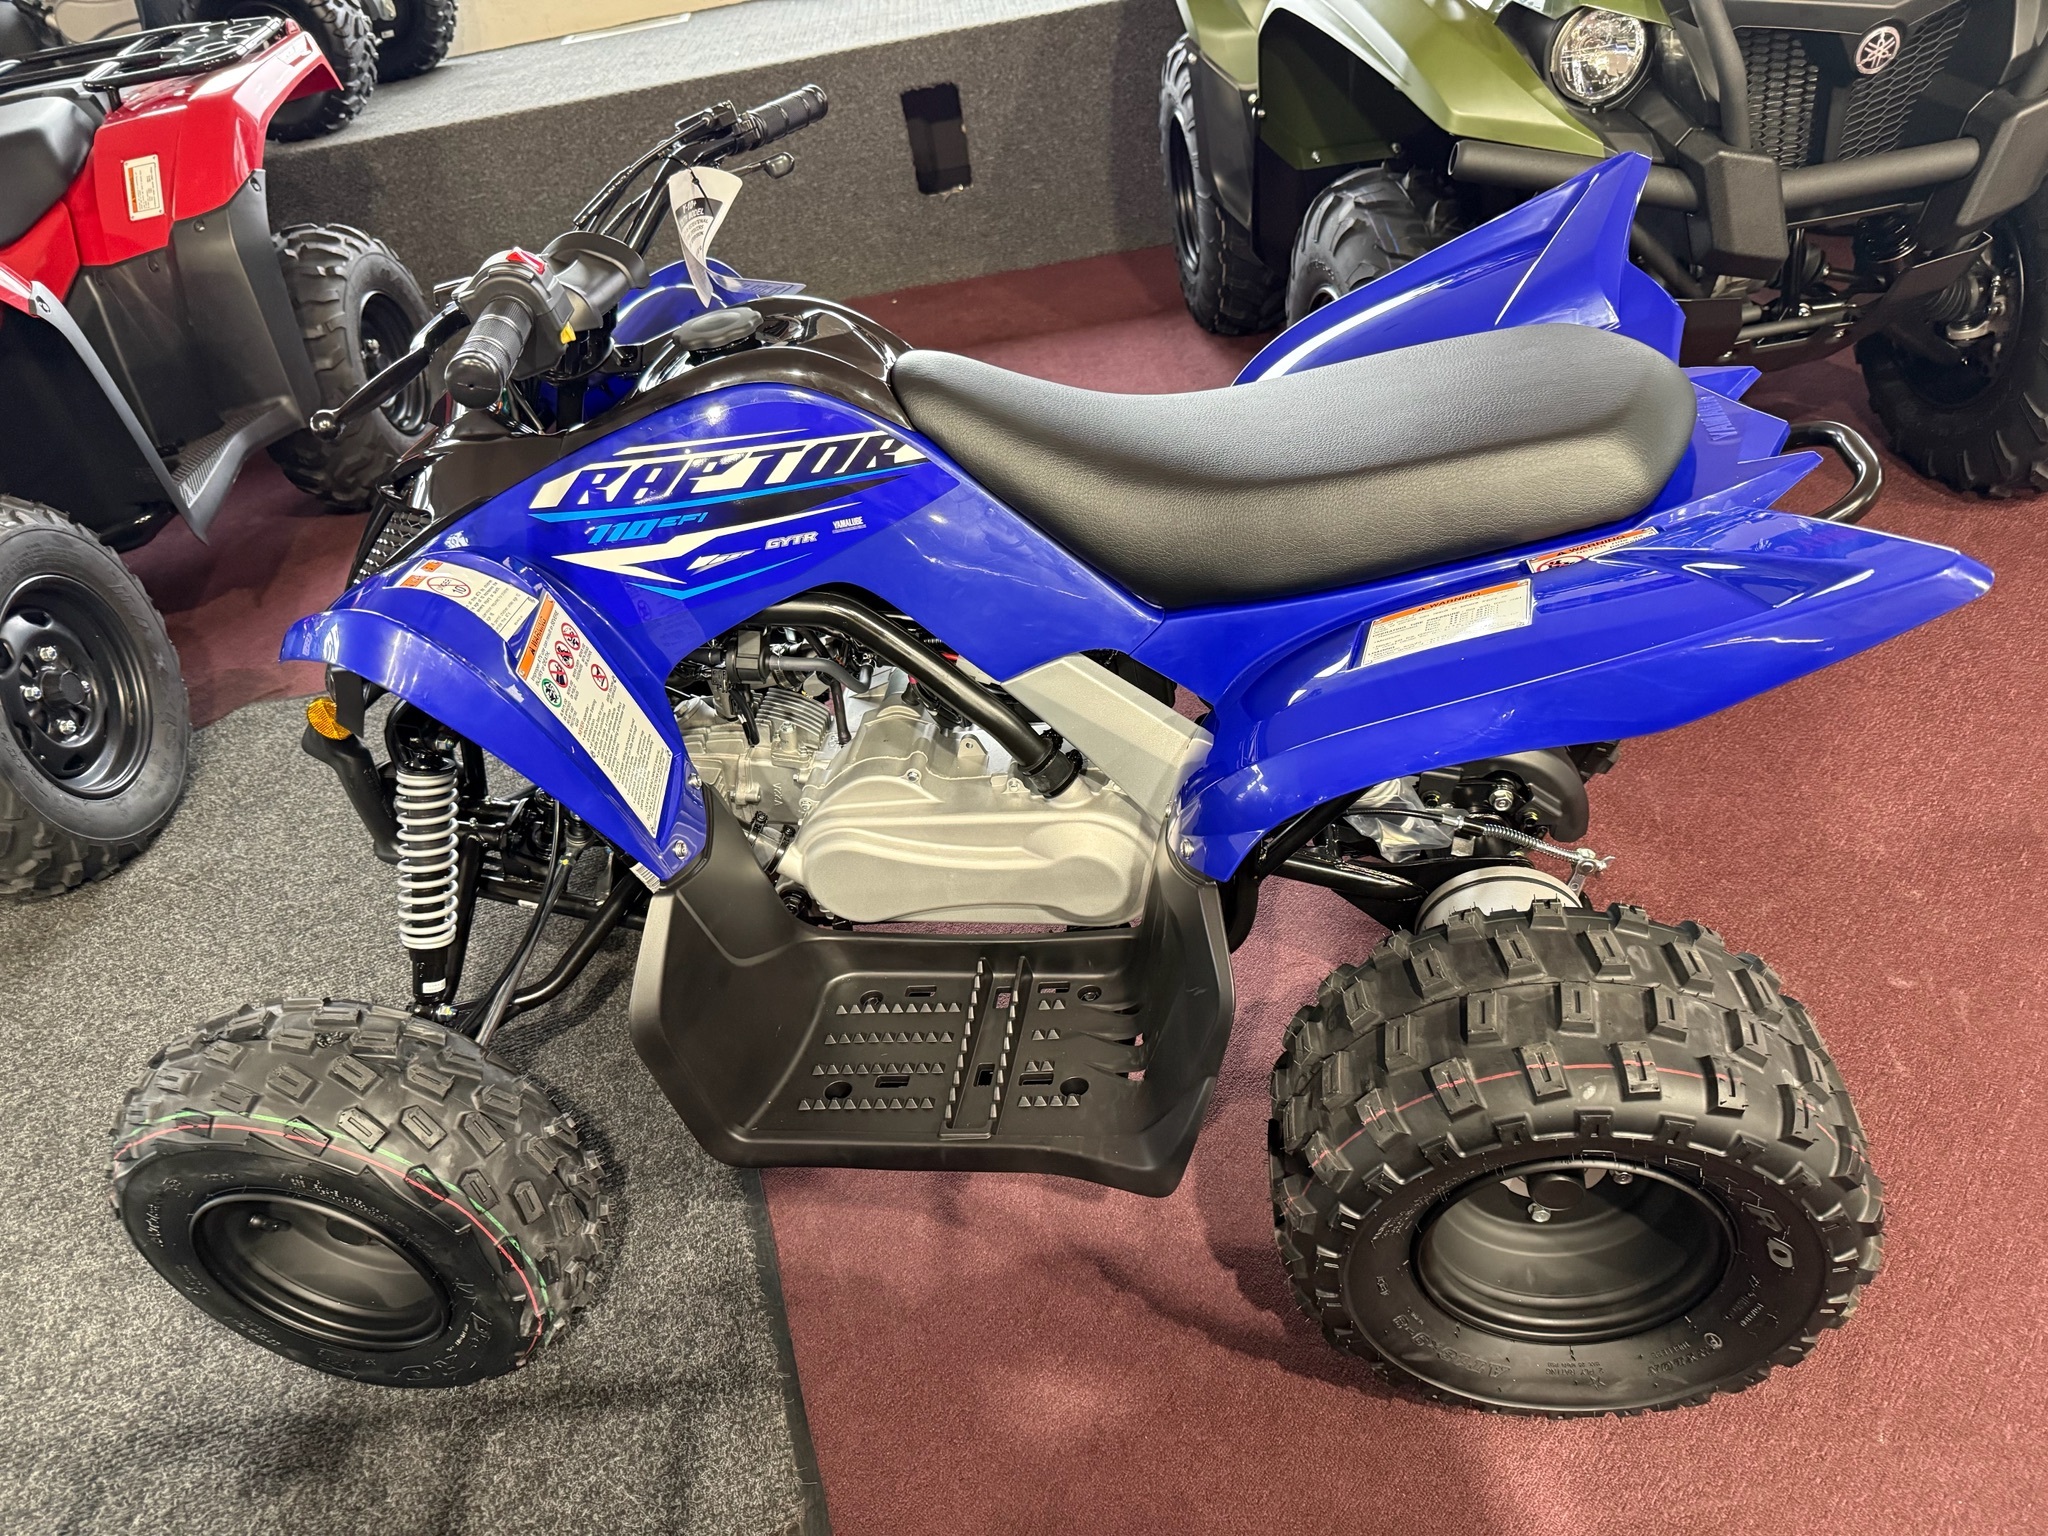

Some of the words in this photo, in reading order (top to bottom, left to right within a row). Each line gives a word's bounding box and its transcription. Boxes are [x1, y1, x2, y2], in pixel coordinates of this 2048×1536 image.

[562, 433, 905, 507] RAPTOR
[657, 512, 706, 529] EFI
[764, 531, 819, 551] GYTR
[1569, 534, 1625, 553] WARNING
[1429, 591, 1481, 610] WARNING
[533, 616, 547, 649] WARNING
